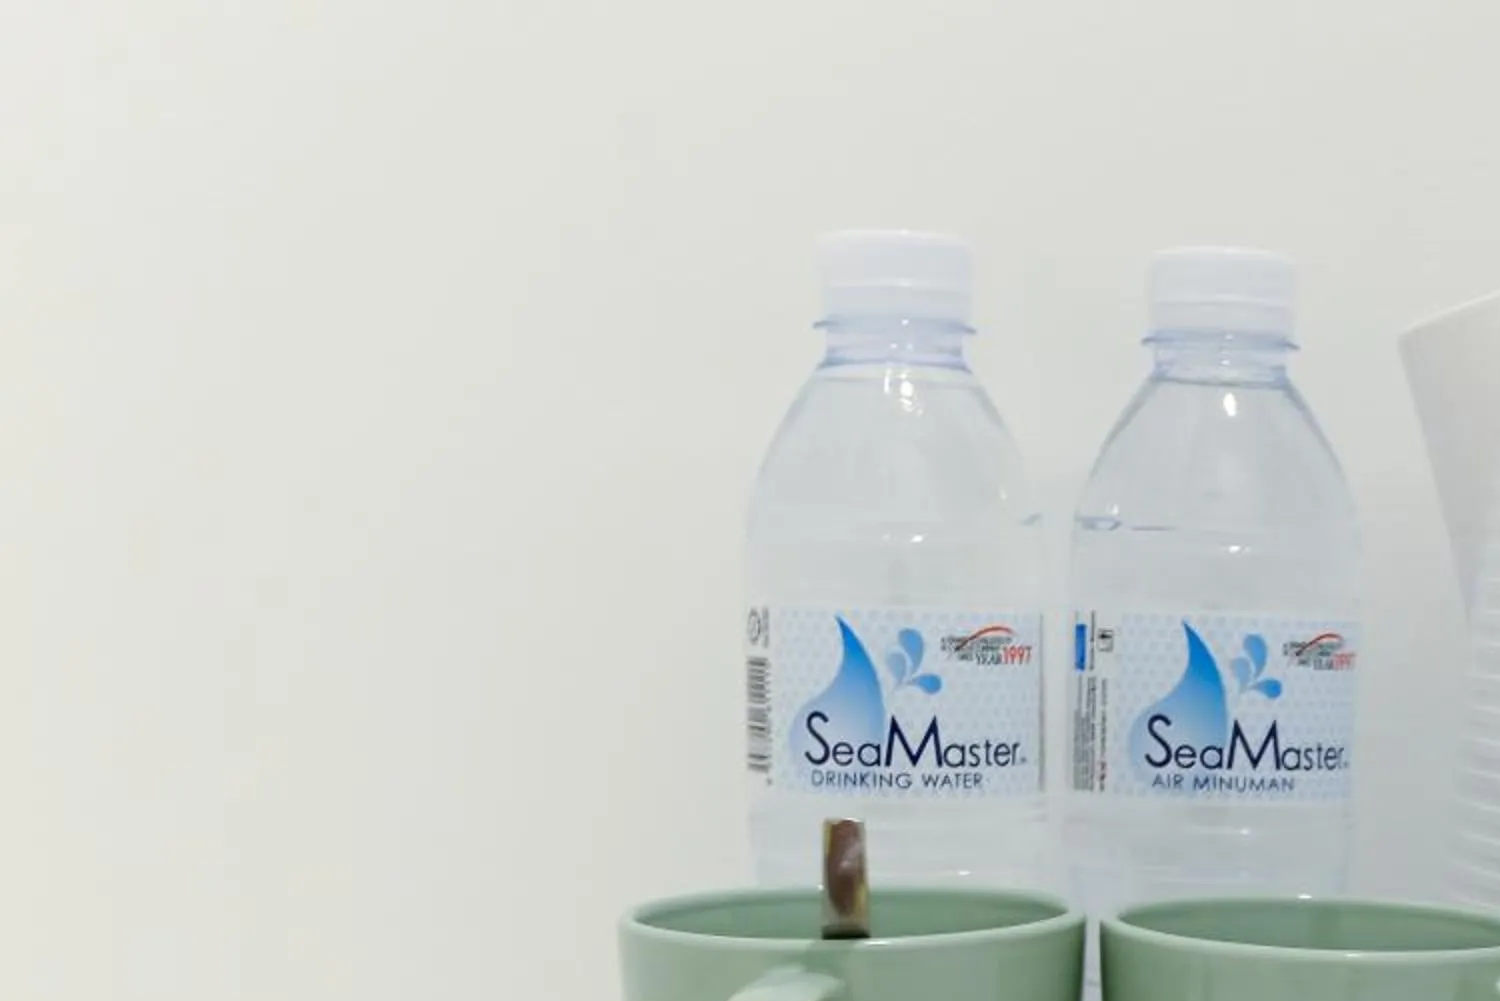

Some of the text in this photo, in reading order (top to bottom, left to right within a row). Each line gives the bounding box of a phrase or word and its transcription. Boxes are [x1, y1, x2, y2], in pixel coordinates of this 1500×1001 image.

[804, 710, 1020, 768] SeaMaster
[1145, 713, 1345, 771] SeaMaster
[811, 770, 983, 790] DRINKING WATER
[1152, 774, 1295, 793] AIR MINUMAN
